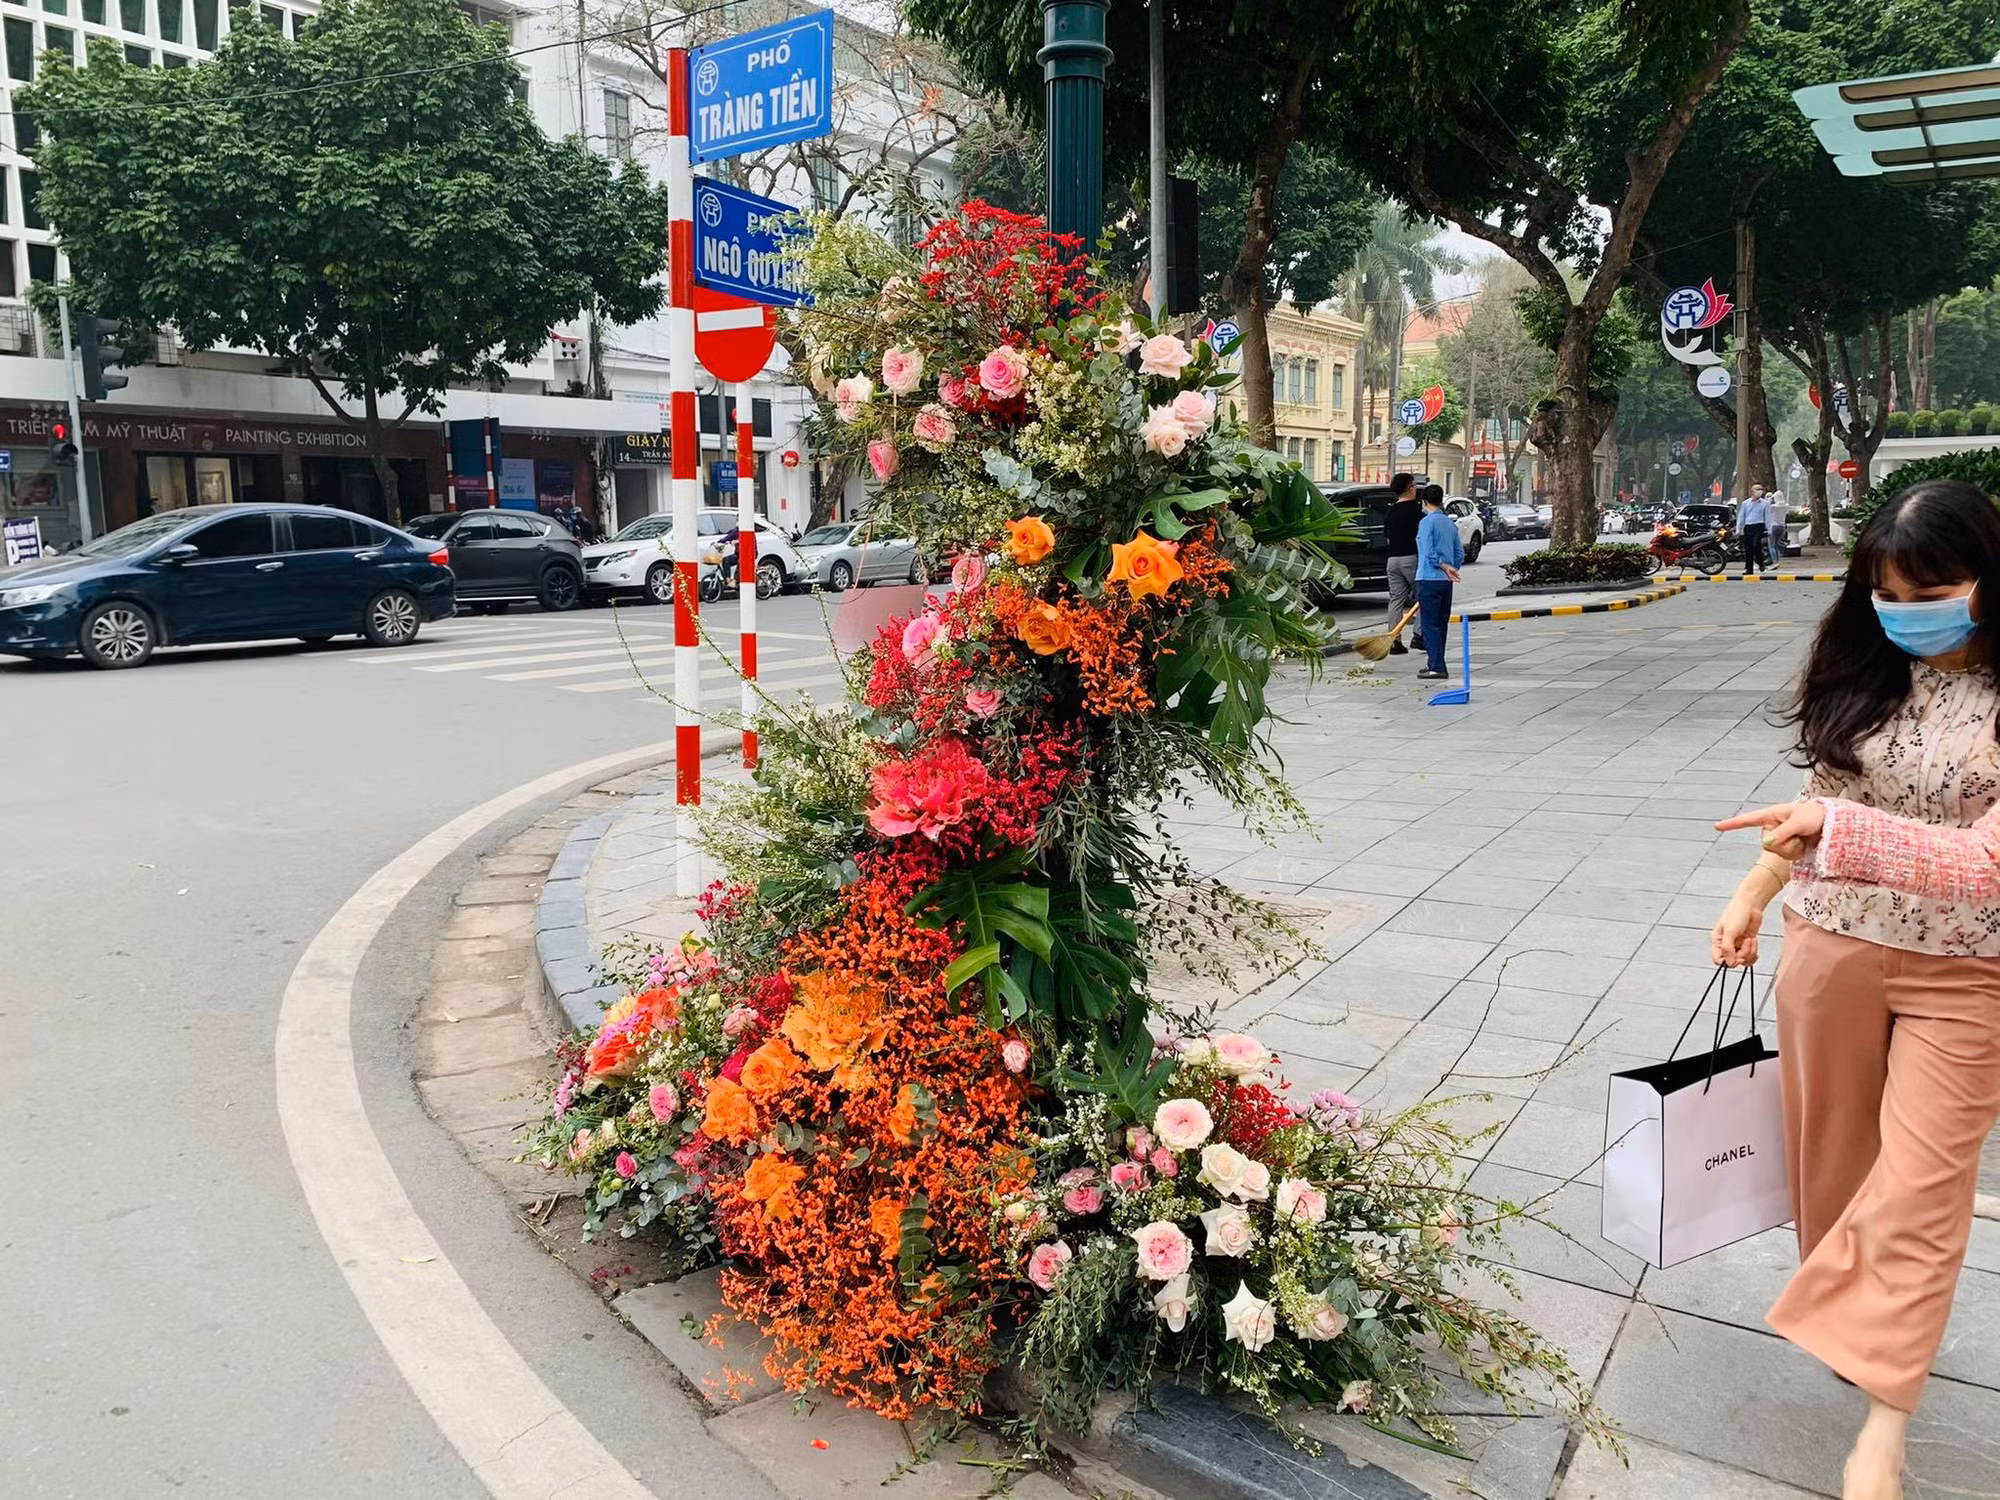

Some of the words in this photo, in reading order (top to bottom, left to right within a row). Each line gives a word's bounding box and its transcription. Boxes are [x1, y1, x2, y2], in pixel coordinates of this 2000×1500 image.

[747, 33, 792, 72] PHỐ
[699, 91, 764, 143] TRÀNG
[769, 68, 817, 126] TIỀN
[704, 236, 741, 279] NGÔ
[225, 429, 291, 444] PAINTING
[297, 432, 366, 447] EXHIBITION
[619, 452, 630, 462] 14
[1705, 1144, 1755, 1171] CHANEL
